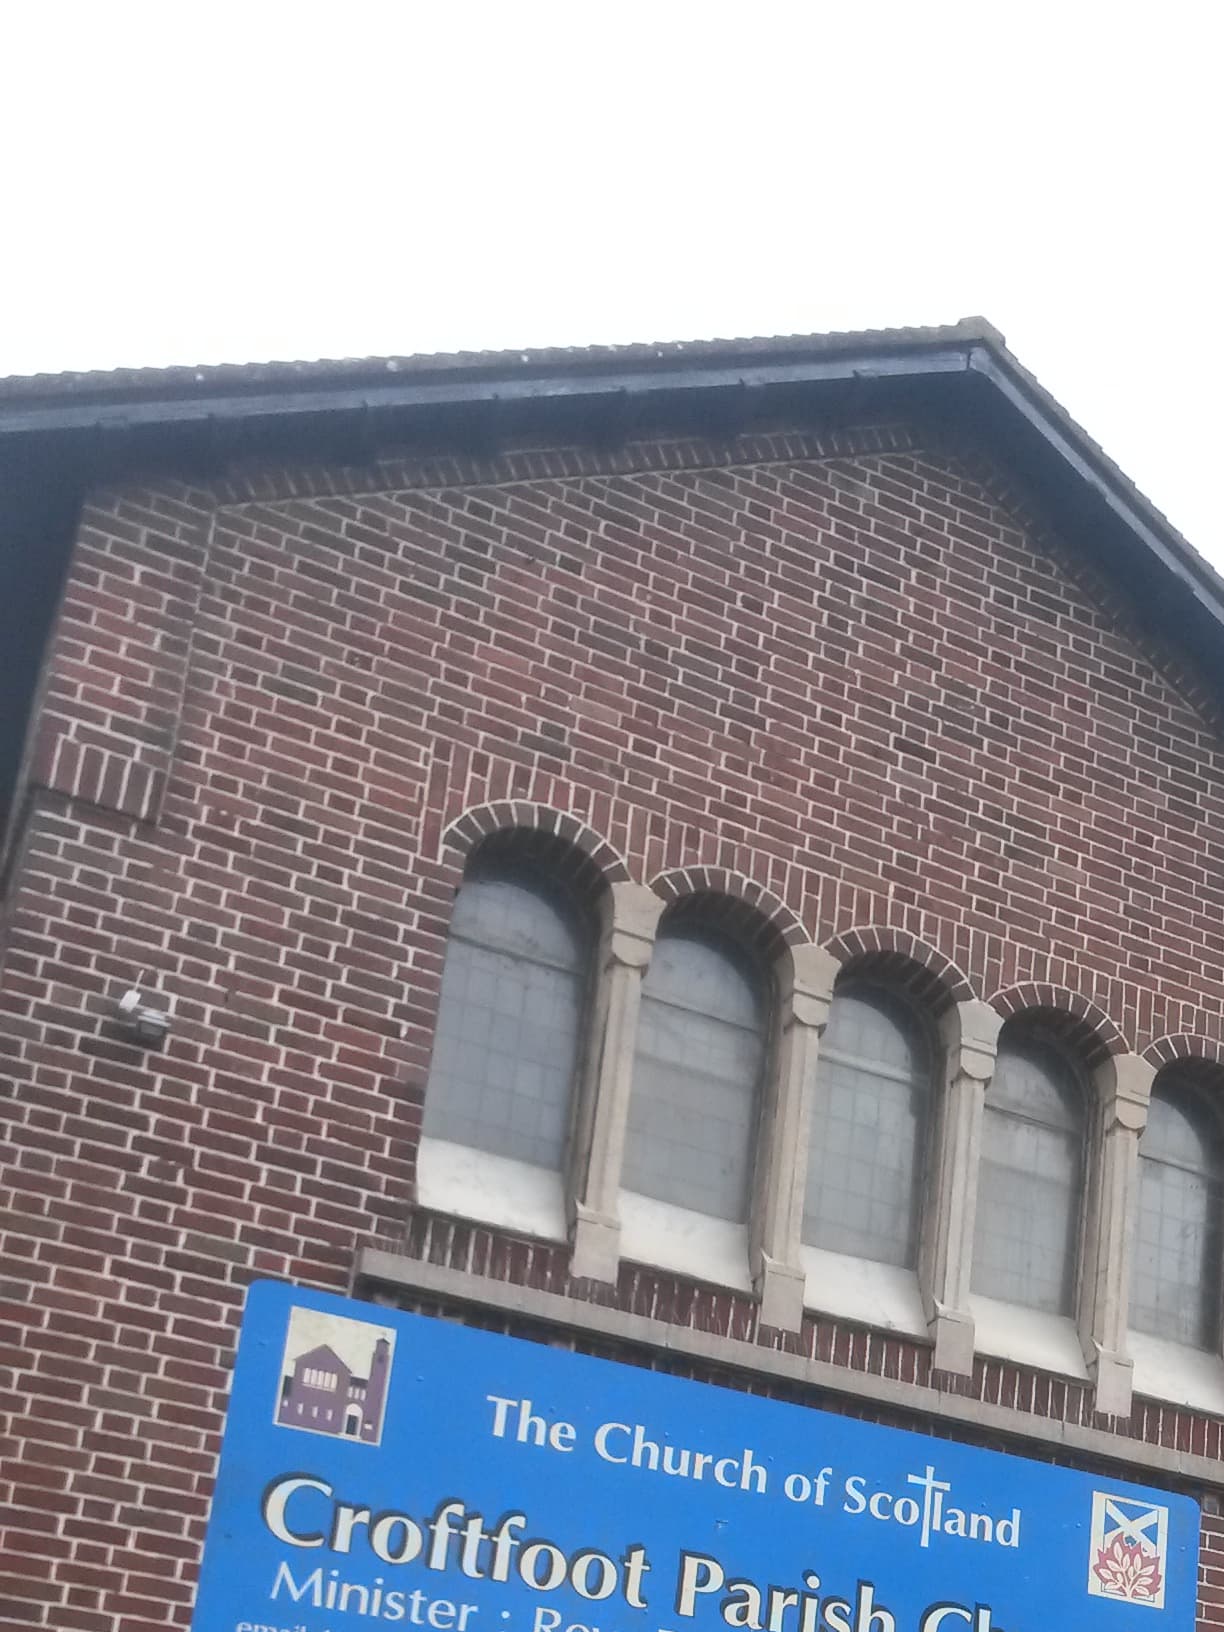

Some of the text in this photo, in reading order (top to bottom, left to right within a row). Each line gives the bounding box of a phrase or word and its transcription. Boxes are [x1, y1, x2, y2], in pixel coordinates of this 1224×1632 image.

[487, 1396, 576, 1451] The
[595, 1423, 766, 1493] Church
[785, 1468, 832, 1505] of
[263, 1476, 650, 1607] Croftfoot
[271, 1562, 477, 1631] Minister
